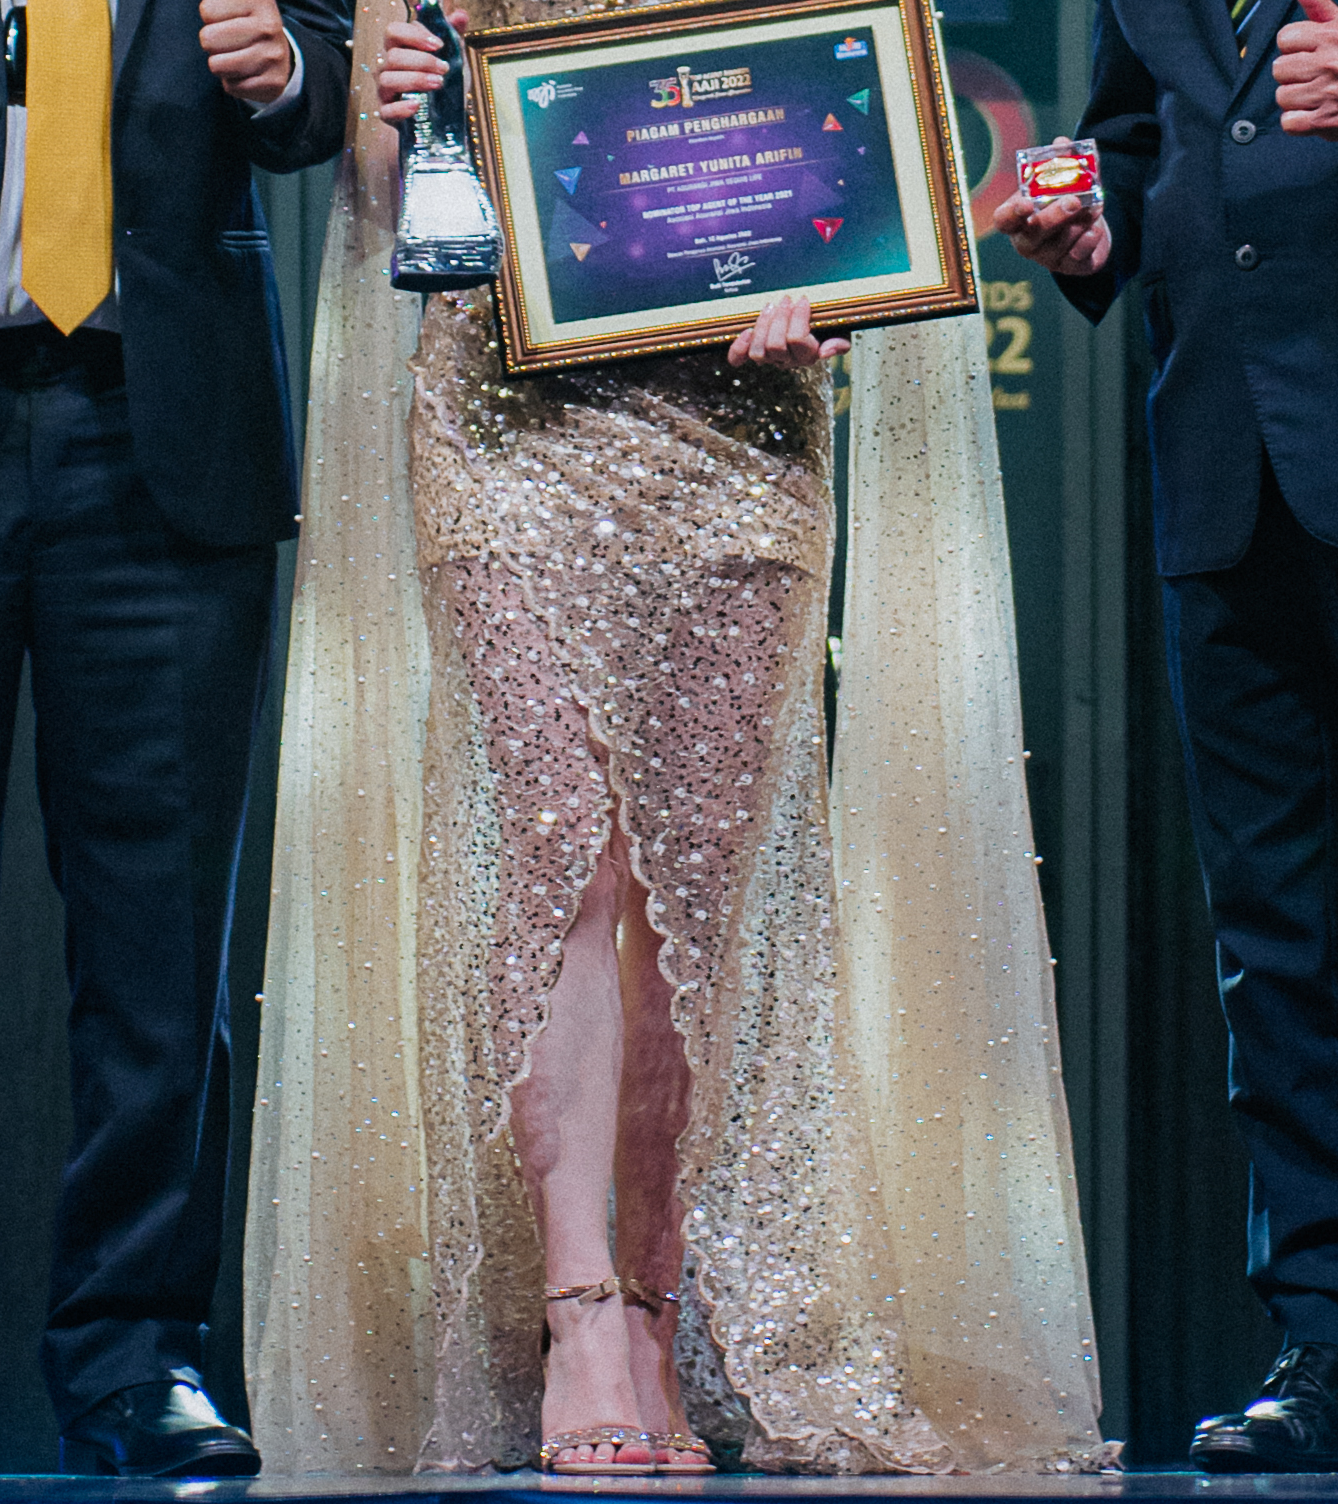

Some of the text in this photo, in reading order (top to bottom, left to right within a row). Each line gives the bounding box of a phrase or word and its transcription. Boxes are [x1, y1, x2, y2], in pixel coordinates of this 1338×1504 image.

[692, 73, 752, 93] AAJI 2022
[627, 124, 680, 143] PIAGAM
[684, 108, 785, 134] PENGHARGAAN
[619, 147, 803, 186] MARGARET YUNITA ARIFIN
